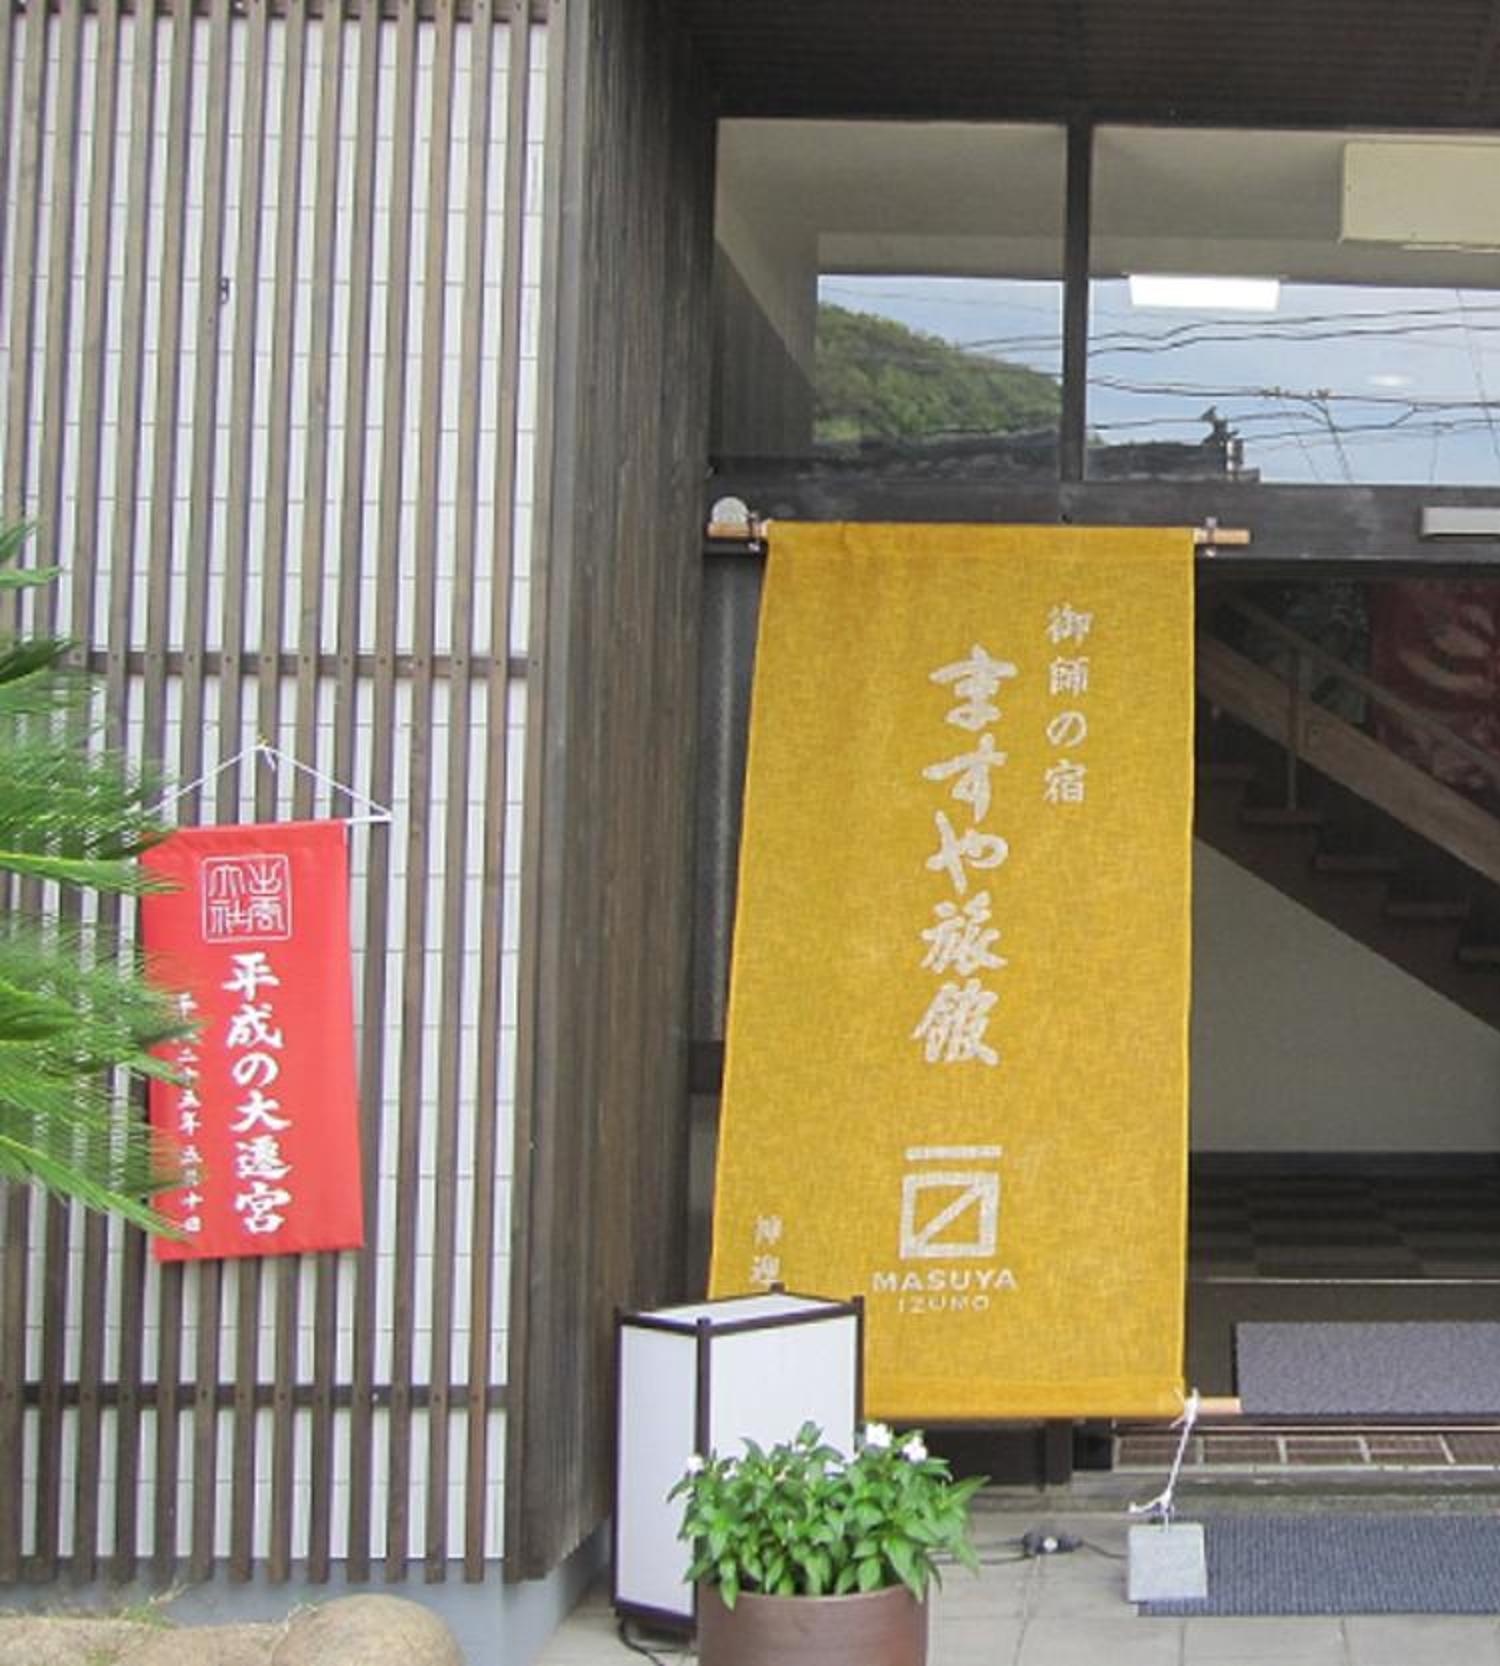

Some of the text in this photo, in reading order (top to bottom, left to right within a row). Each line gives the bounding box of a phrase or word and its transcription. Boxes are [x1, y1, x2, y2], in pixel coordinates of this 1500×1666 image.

[1044, 602, 1093, 806] 御師の宿
[911, 644, 1019, 1067] ますや旅館
[222, 952, 292, 1236] 平成の大遷宮
[872, 1268, 1018, 1293] MASUYA
[898, 1295, 991, 1314] IZUMO
